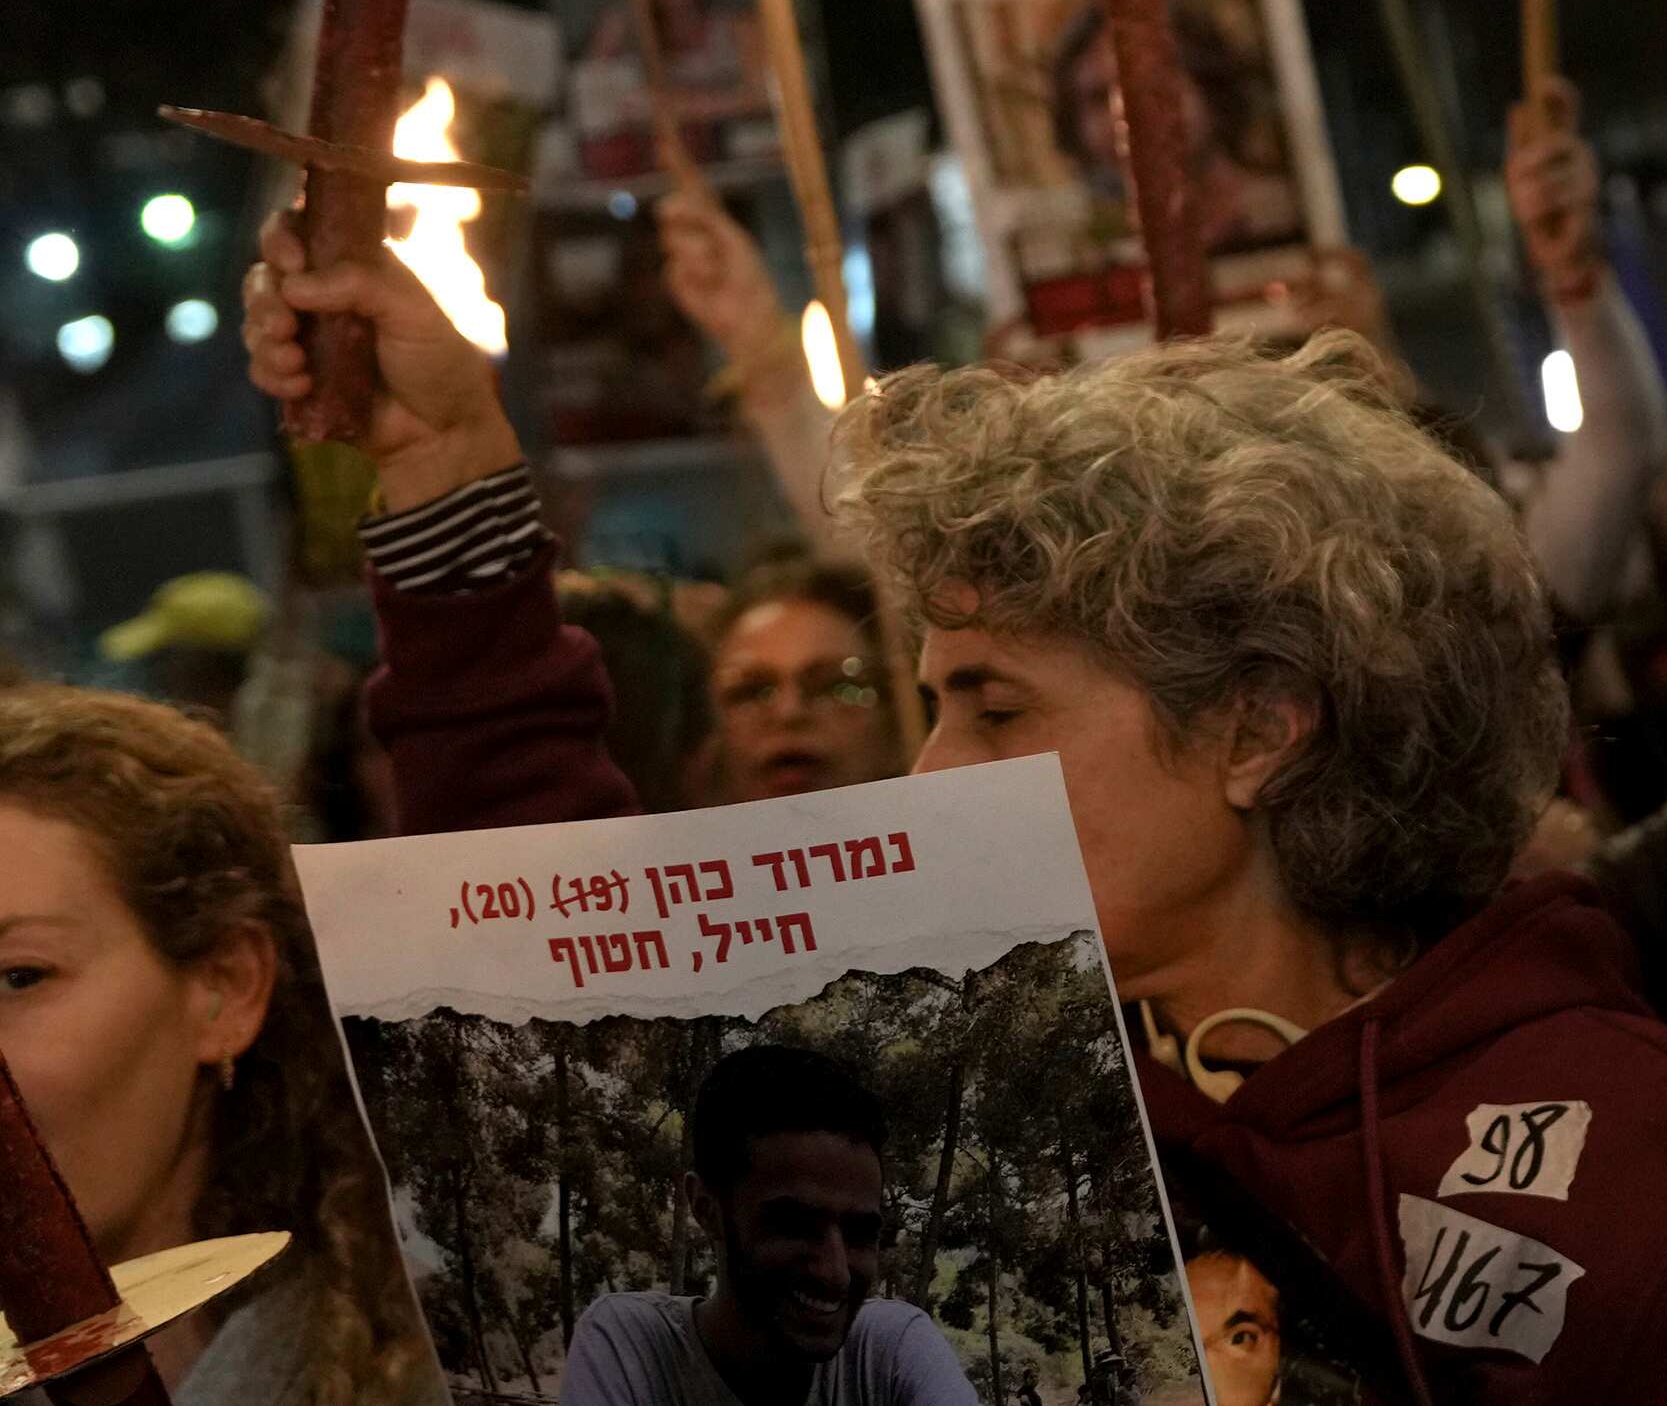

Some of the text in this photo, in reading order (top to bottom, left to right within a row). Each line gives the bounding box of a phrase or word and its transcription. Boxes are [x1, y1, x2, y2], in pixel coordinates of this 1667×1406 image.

[645, 859, 736, 920] כהן
[751, 831, 917, 893] נמרוד
[548, 911, 819, 989] חייל, חטוף
[1460, 1103, 1571, 1191] 98
[1414, 1225, 1564, 1338] 467
